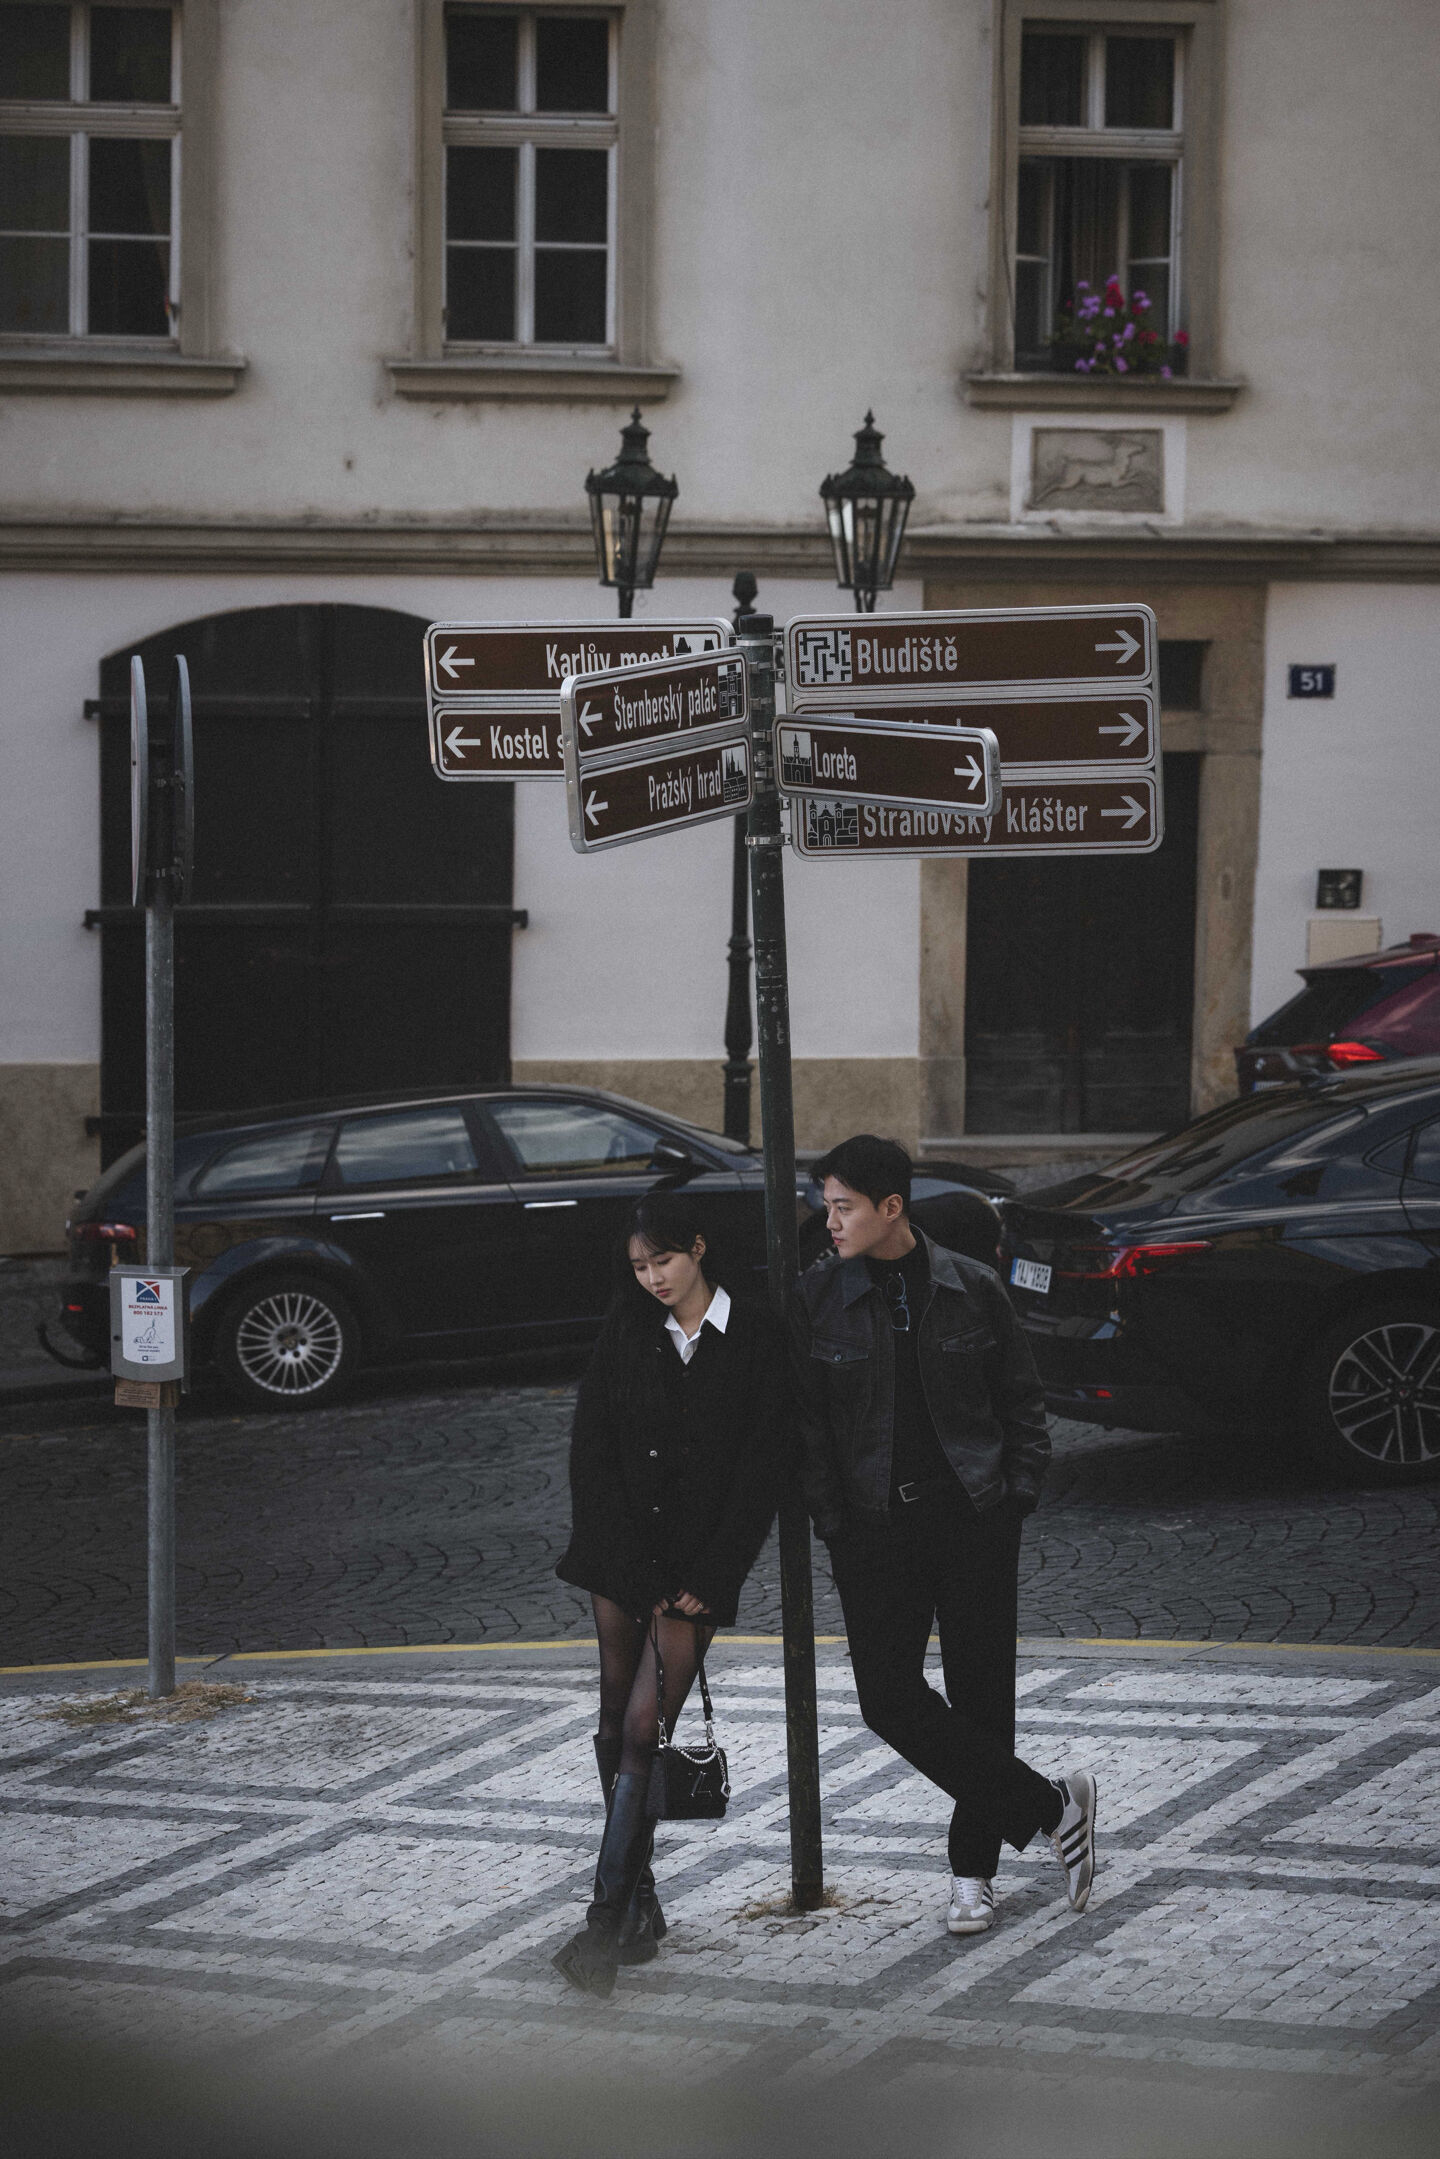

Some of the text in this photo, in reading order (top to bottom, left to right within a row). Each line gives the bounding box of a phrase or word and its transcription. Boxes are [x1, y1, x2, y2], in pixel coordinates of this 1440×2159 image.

[546, 643, 611, 678] Karlův
[857, 636, 958, 674] Bludiště
[1300, 672, 1324, 691] 51
[613, 678, 717, 732] Šternberský palác
[490, 725, 550, 760] Kostel
[813, 741, 857, 780] Loreta
[648, 760, 722, 812] Pražský hrad
[1006, 797, 1088, 833] klášter
